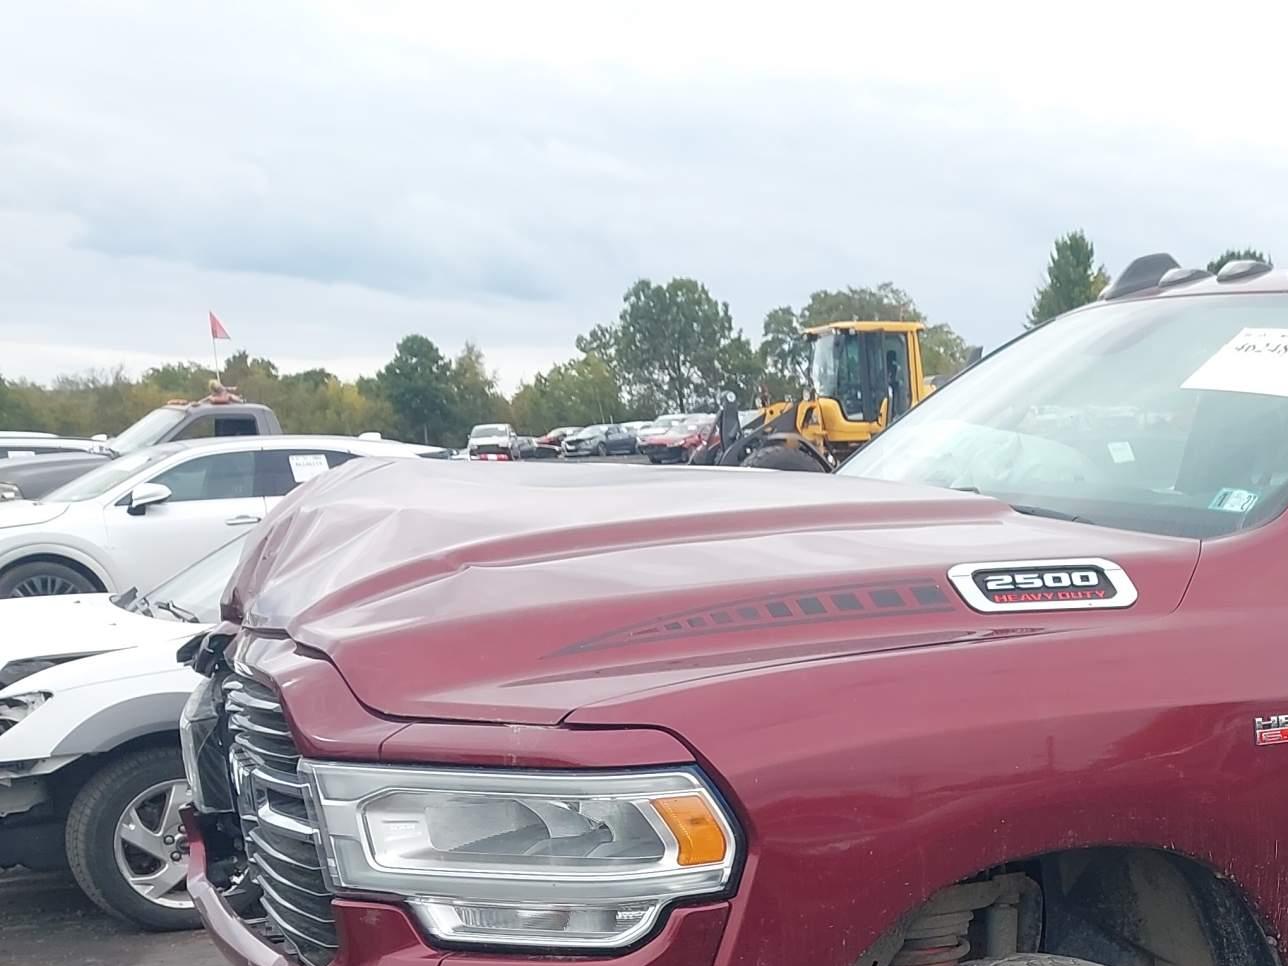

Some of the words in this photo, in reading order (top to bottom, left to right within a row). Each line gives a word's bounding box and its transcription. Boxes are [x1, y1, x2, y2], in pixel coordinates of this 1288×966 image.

[985, 571, 1099, 591] 2500
[993, 592, 1054, 603] HEAVY
[1057, 590, 1106, 600] DUTY
